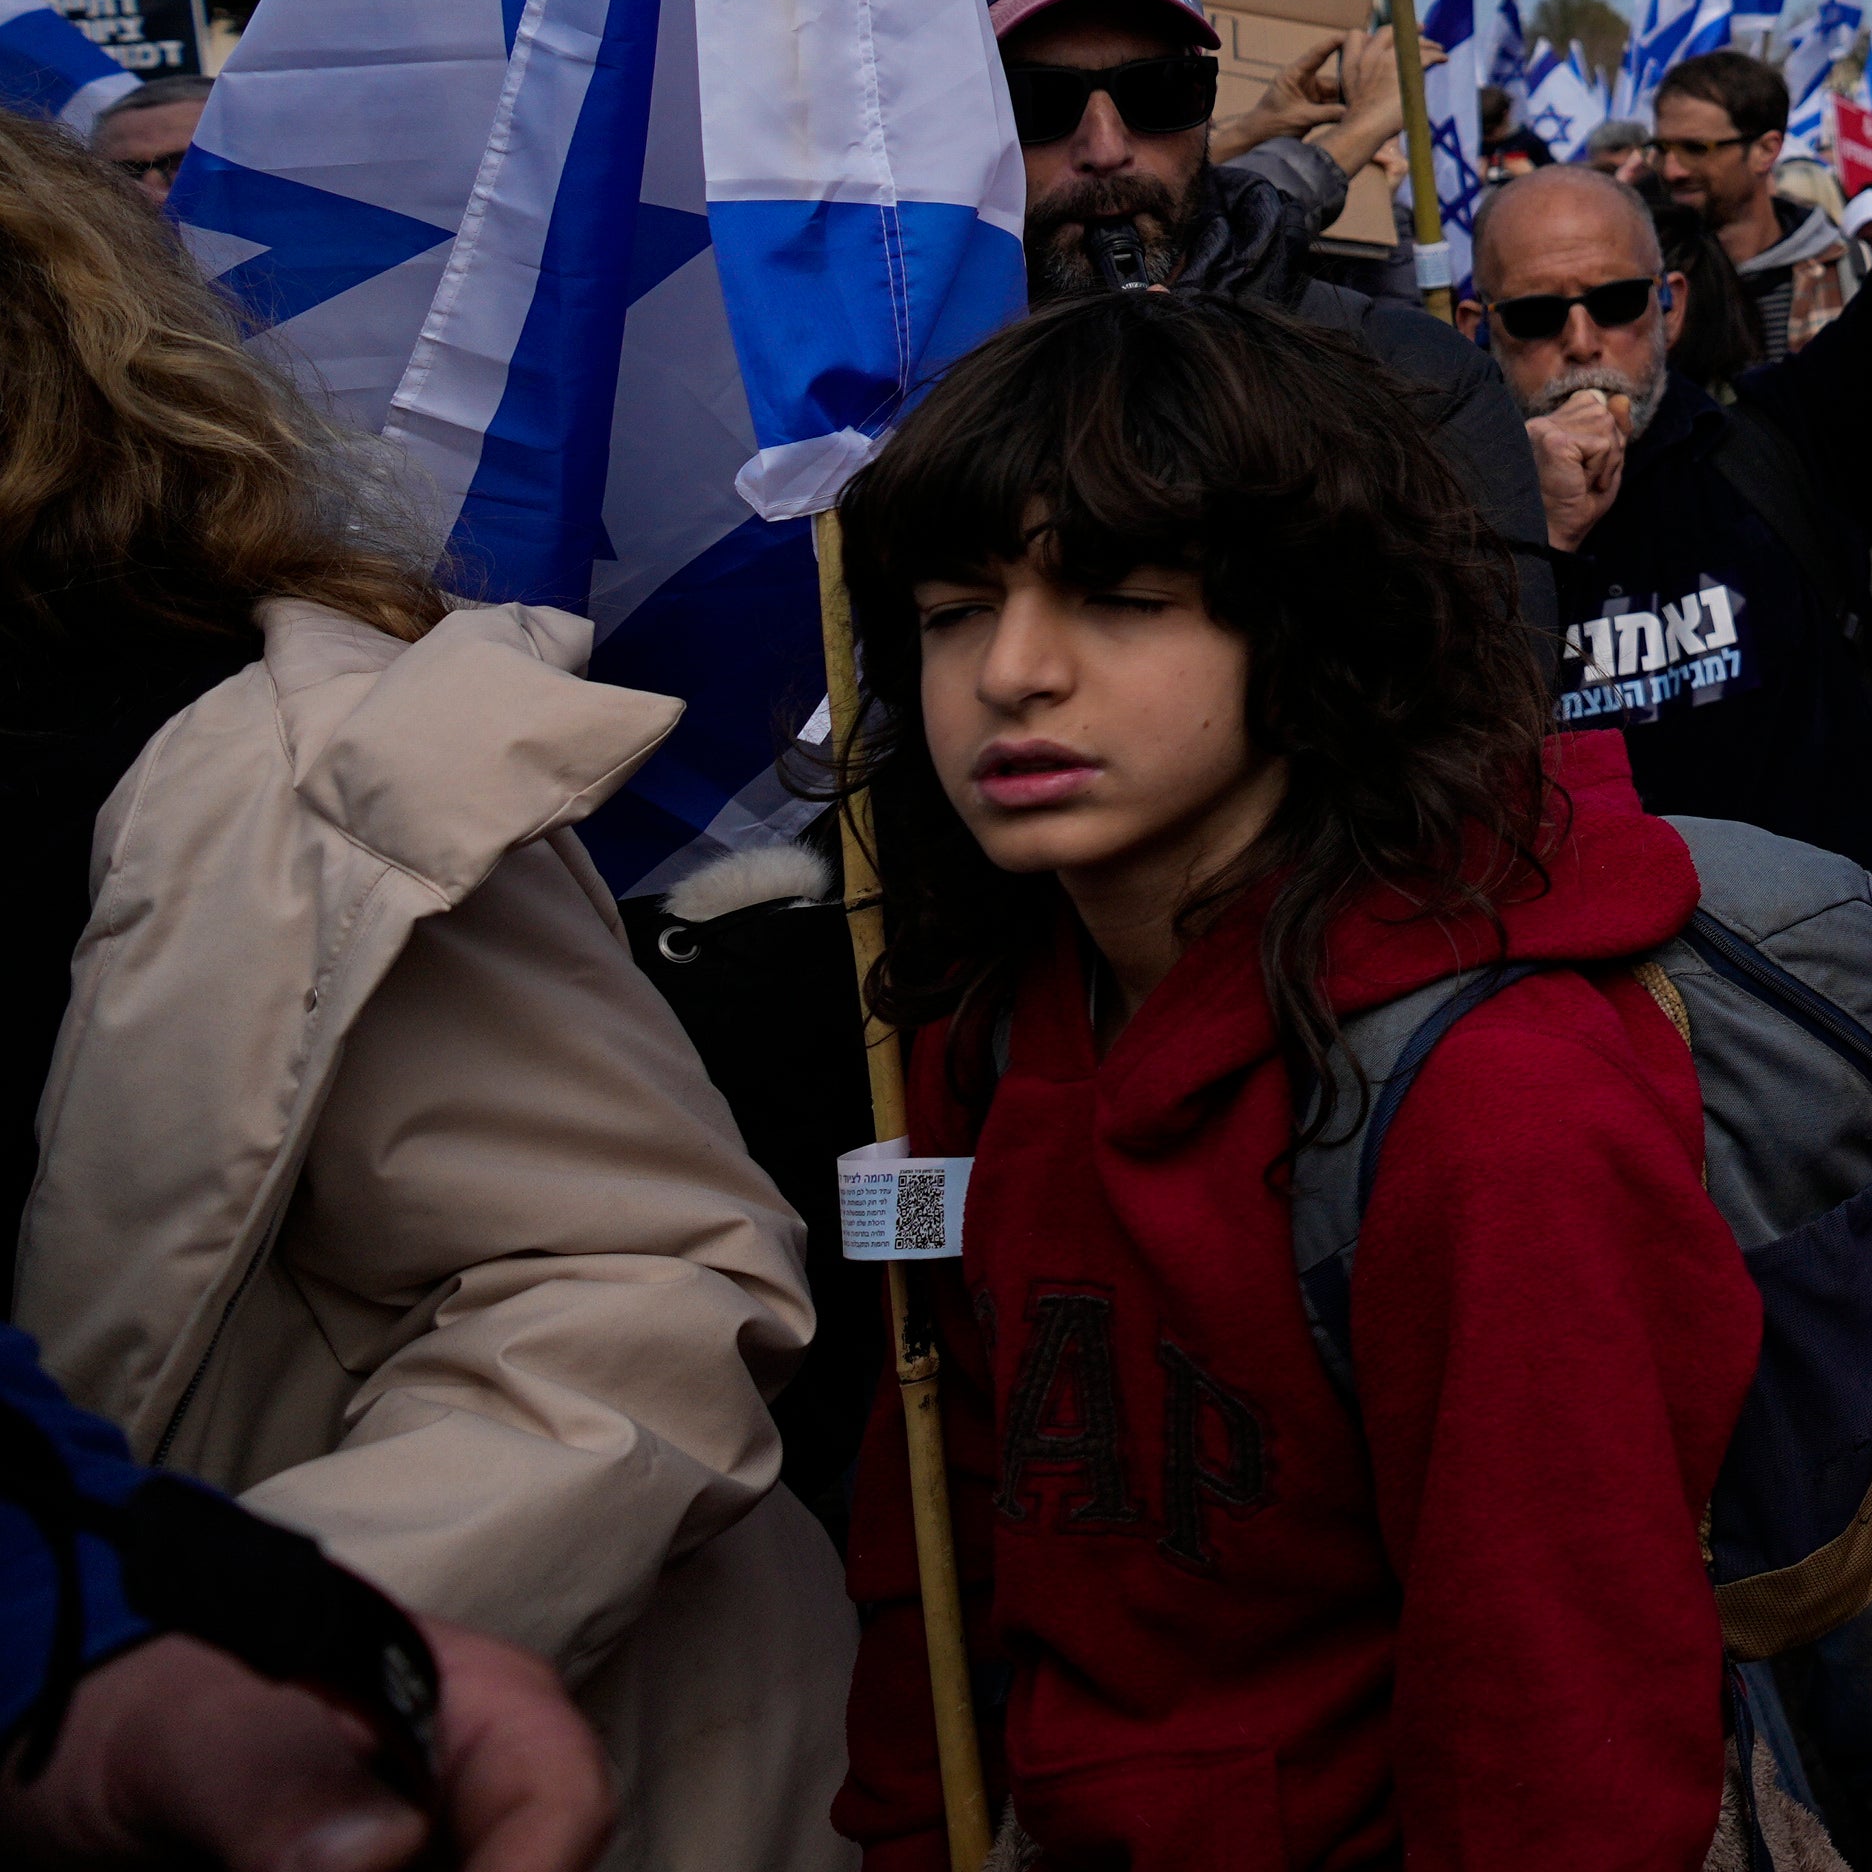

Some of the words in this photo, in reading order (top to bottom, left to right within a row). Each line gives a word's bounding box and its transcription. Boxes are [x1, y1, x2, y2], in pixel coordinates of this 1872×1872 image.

[1562, 584, 1739, 682] נאמני
[1559, 678, 1648, 722] העצמ
[1650, 646, 1743, 705] למגילת
[864, 1173, 893, 1183] תרומה
[974, 1289, 1274, 1570] AP
